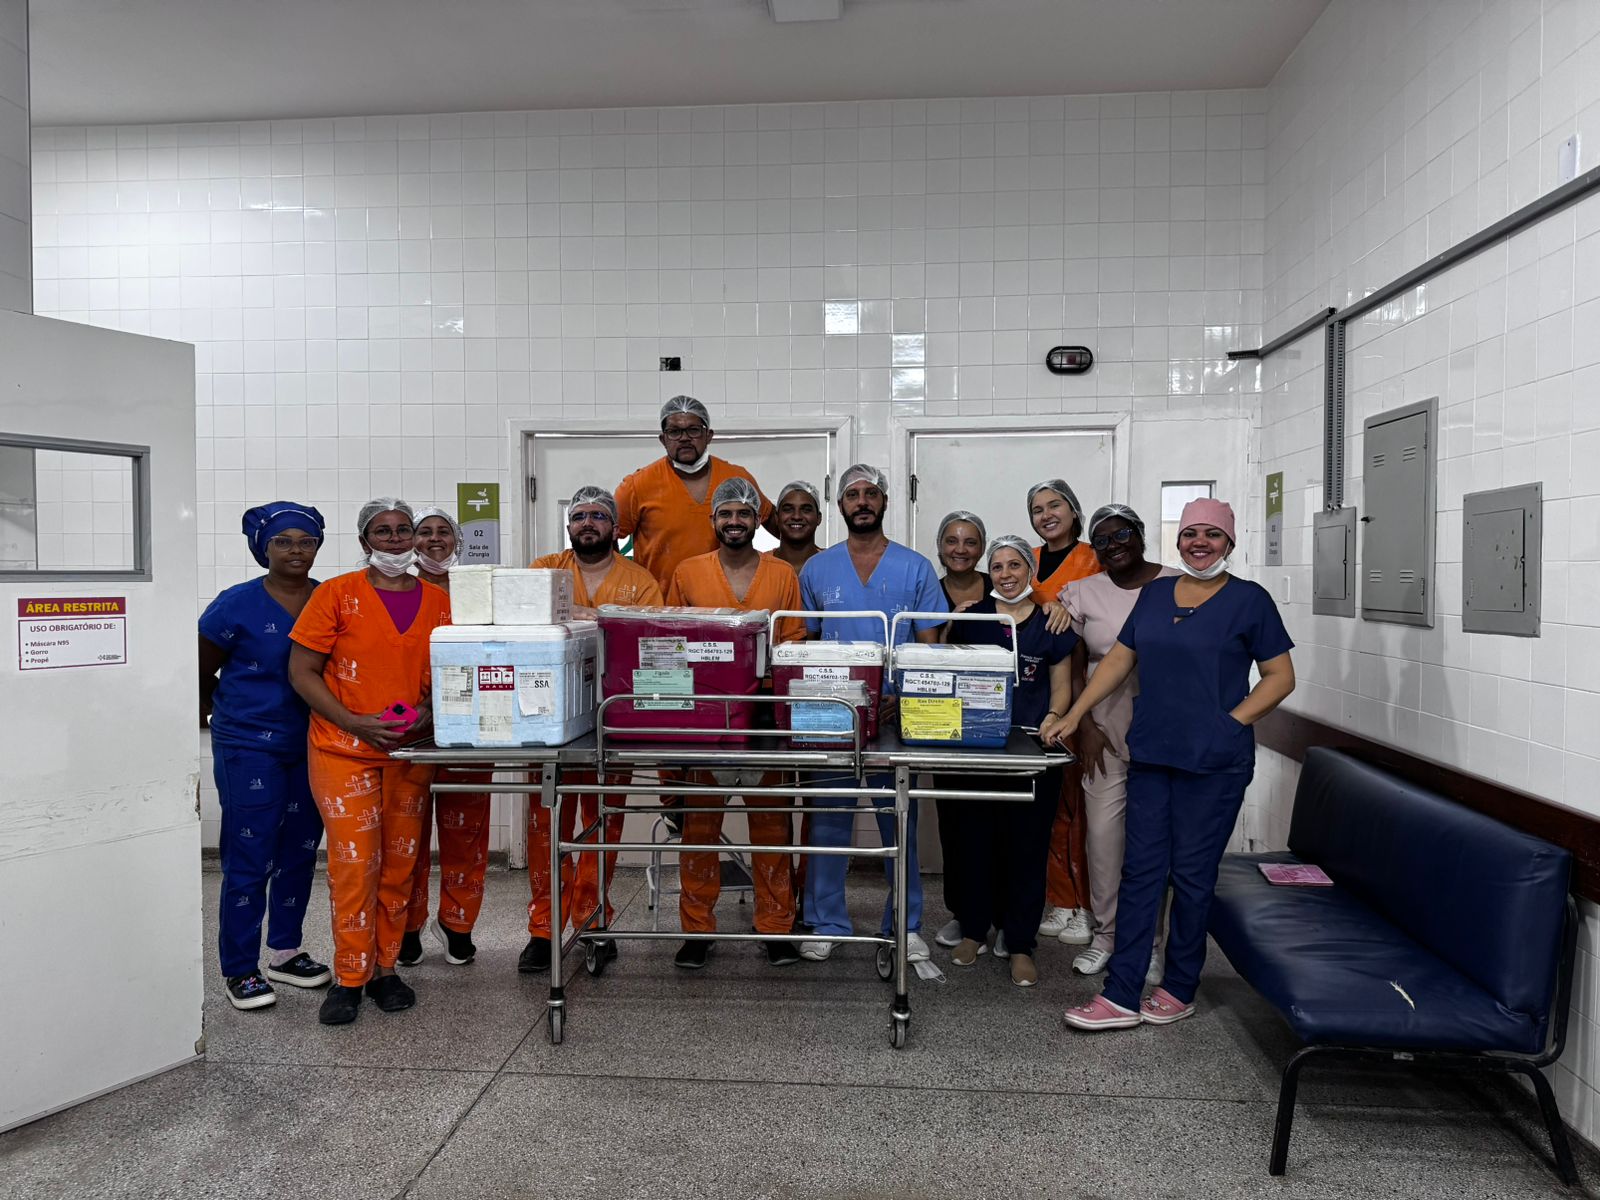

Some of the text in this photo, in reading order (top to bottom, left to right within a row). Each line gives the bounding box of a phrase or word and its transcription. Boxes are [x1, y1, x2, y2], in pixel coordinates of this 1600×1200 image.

[26, 601, 119, 613] ÁREA RESTRITA
[49, 622, 101, 632] OBRIGATÓRIO
[534, 680, 550, 688] SSA
